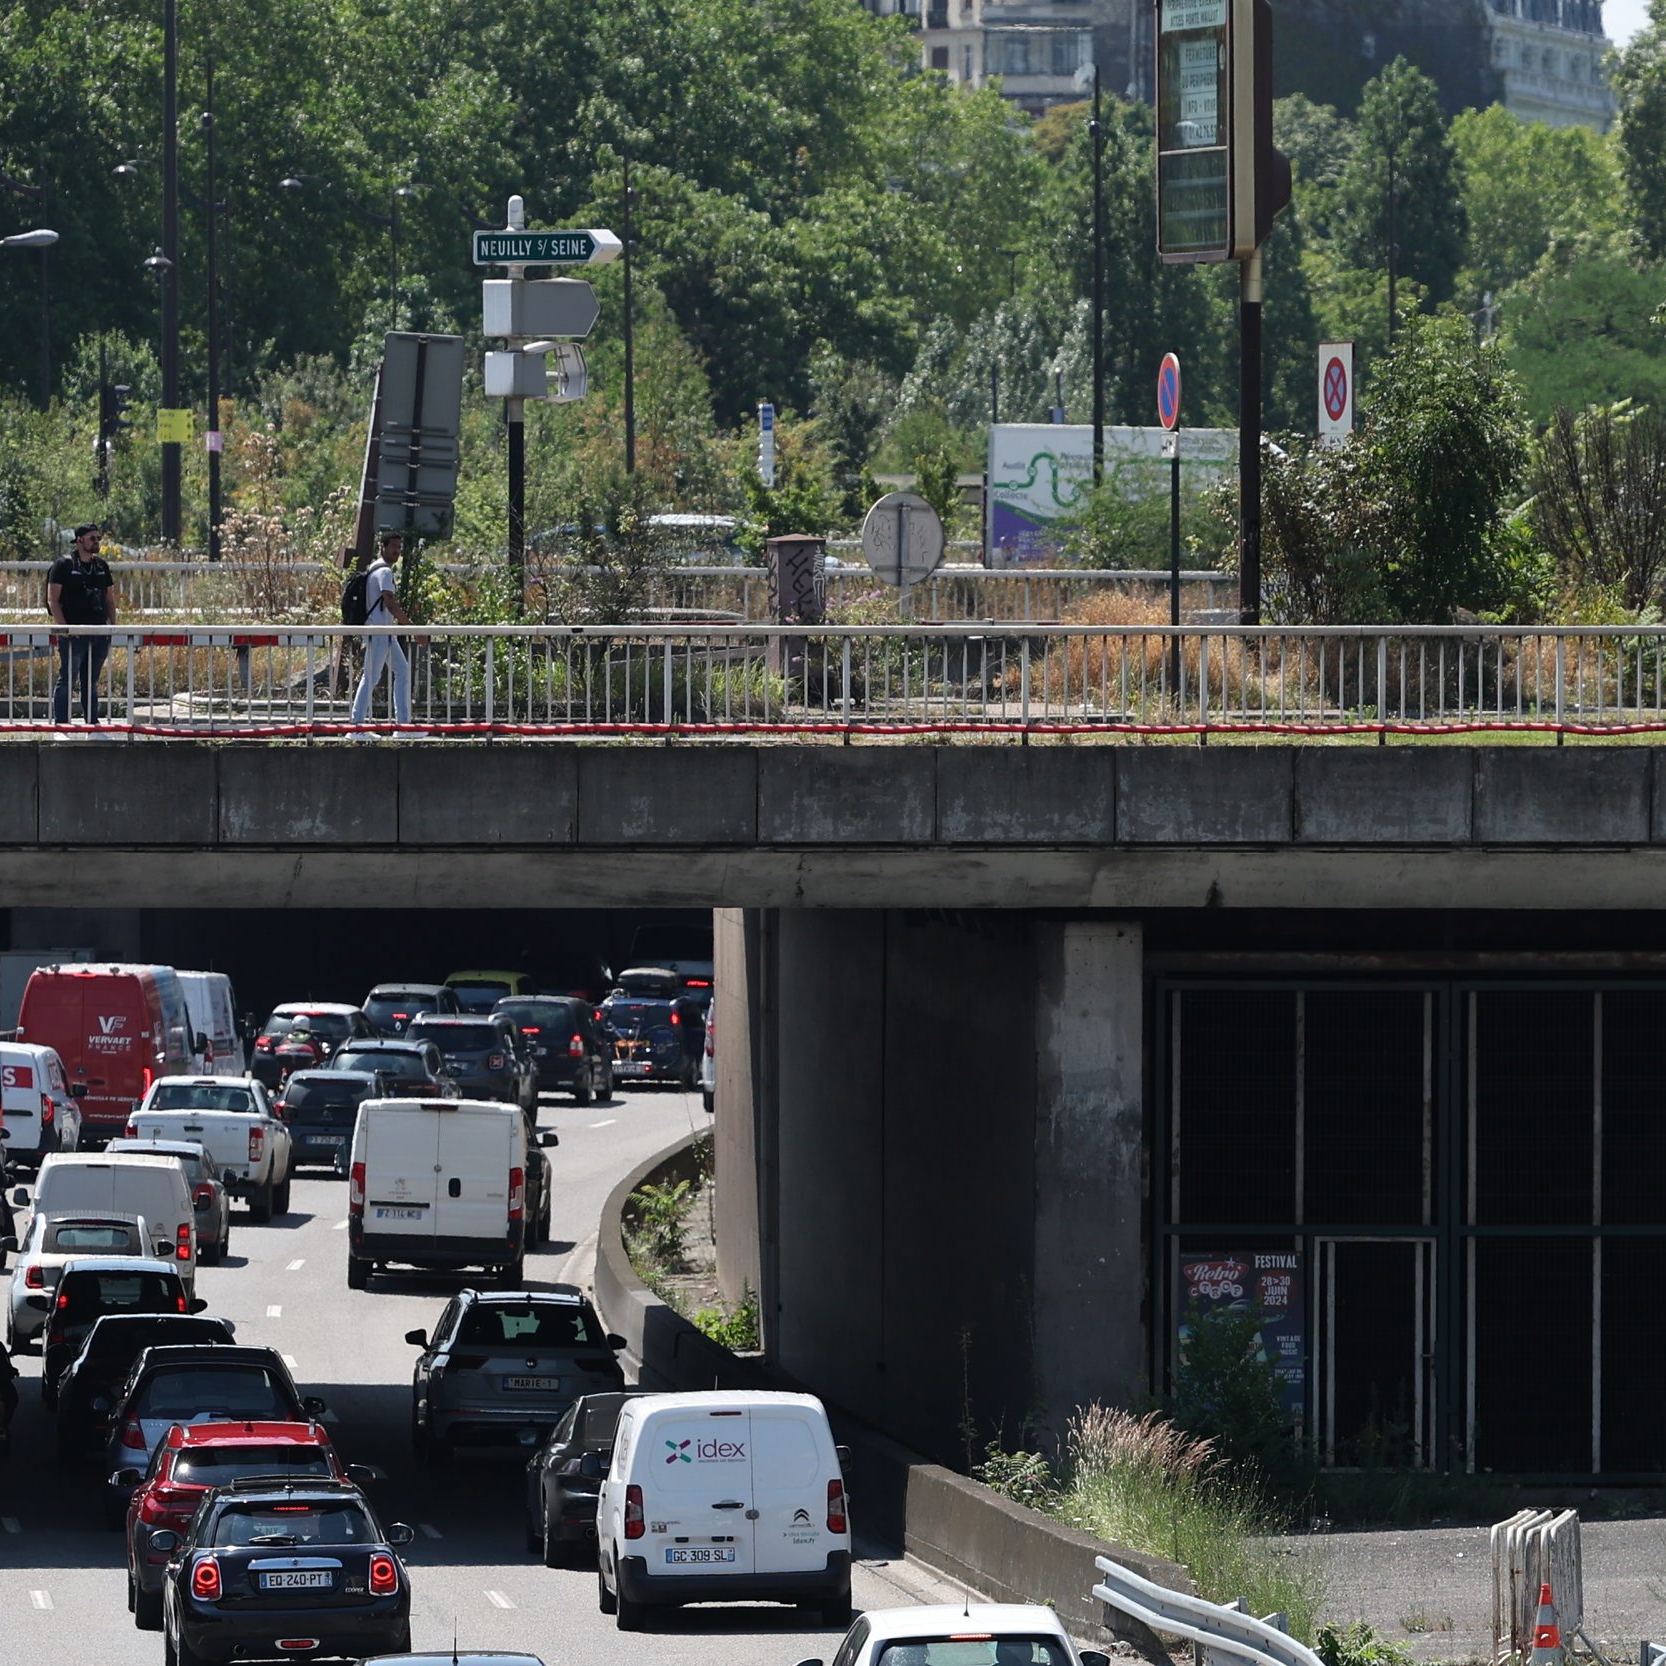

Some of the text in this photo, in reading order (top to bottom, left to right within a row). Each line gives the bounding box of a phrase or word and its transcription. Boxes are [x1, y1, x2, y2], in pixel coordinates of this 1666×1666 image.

[480, 239, 532, 257] NEUILLY
[550, 239, 587, 256] SEINE
[88, 1035, 132, 1045] VERVAET
[1255, 1254, 1297, 1269] FESTIVAL
[1193, 1263, 1239, 1281] Retro
[1261, 1275, 1290, 1286] 28>30
[1264, 1286, 1288, 1296] JUIN
[1264, 1295, 1288, 1306] 2024
[697, 1438, 746, 1458] idex
[673, 1550, 728, 1562] GC-309-SL
[269, 1573, 324, 1587] EQ-240-PT
